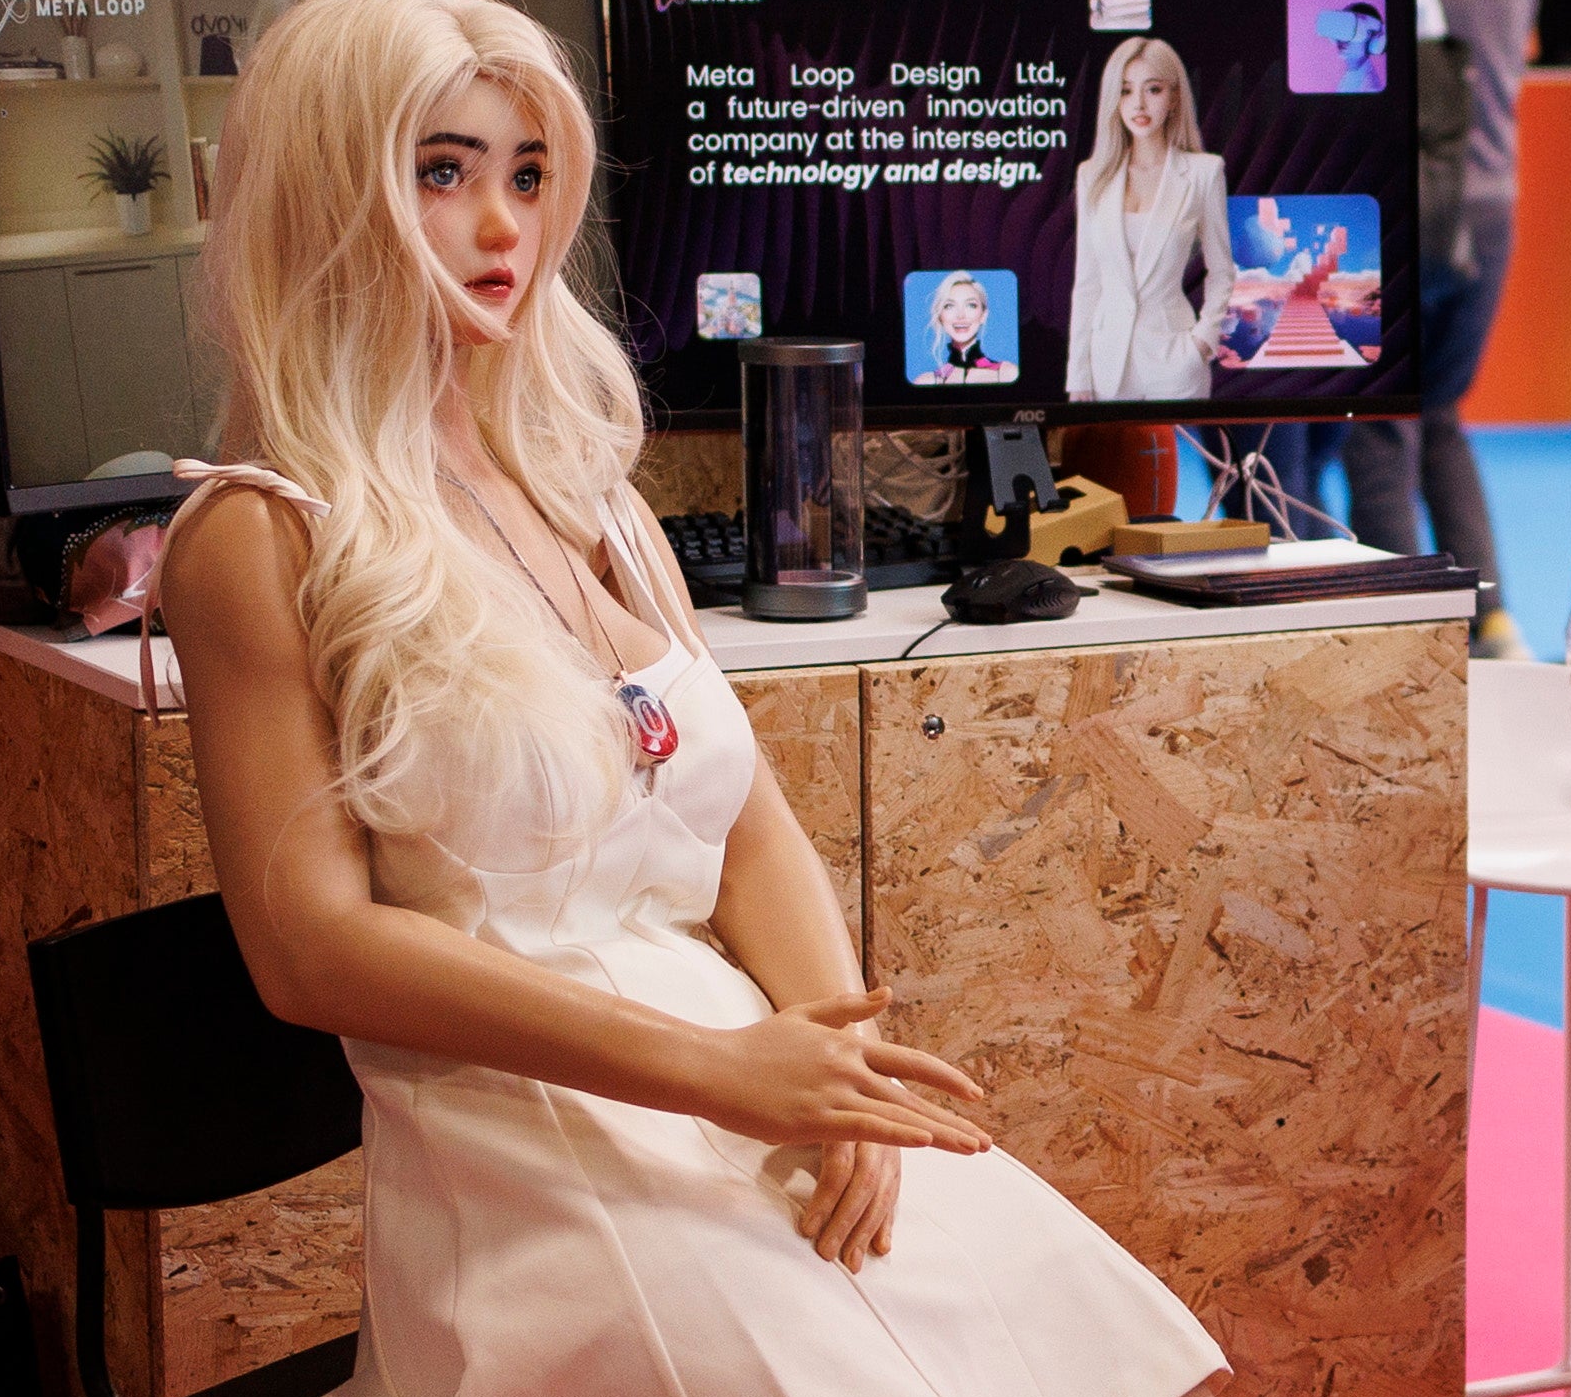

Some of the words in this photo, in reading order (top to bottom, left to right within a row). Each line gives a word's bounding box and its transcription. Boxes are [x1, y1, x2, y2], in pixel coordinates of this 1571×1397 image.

[687, 64, 755, 87] Meta
[790, 64, 856, 92] Loop
[890, 63, 981, 90] Design
[1016, 61, 1066, 87] Ltd.,
[687, 100, 705, 120] a
[728, 94, 905, 119] future-driven
[927, 93, 1067, 117] innovation
[688, 130, 818, 157] company
[825, 129, 855, 151] at
[861, 128, 905, 150] the
[912, 126, 1067, 149] intersection
[689, 161, 717, 185] of
[722, 160, 880, 190] technology
[883, 158, 938, 184] and
[943, 156, 1043, 188] design.
[1013, 410, 1046, 423] AOC
